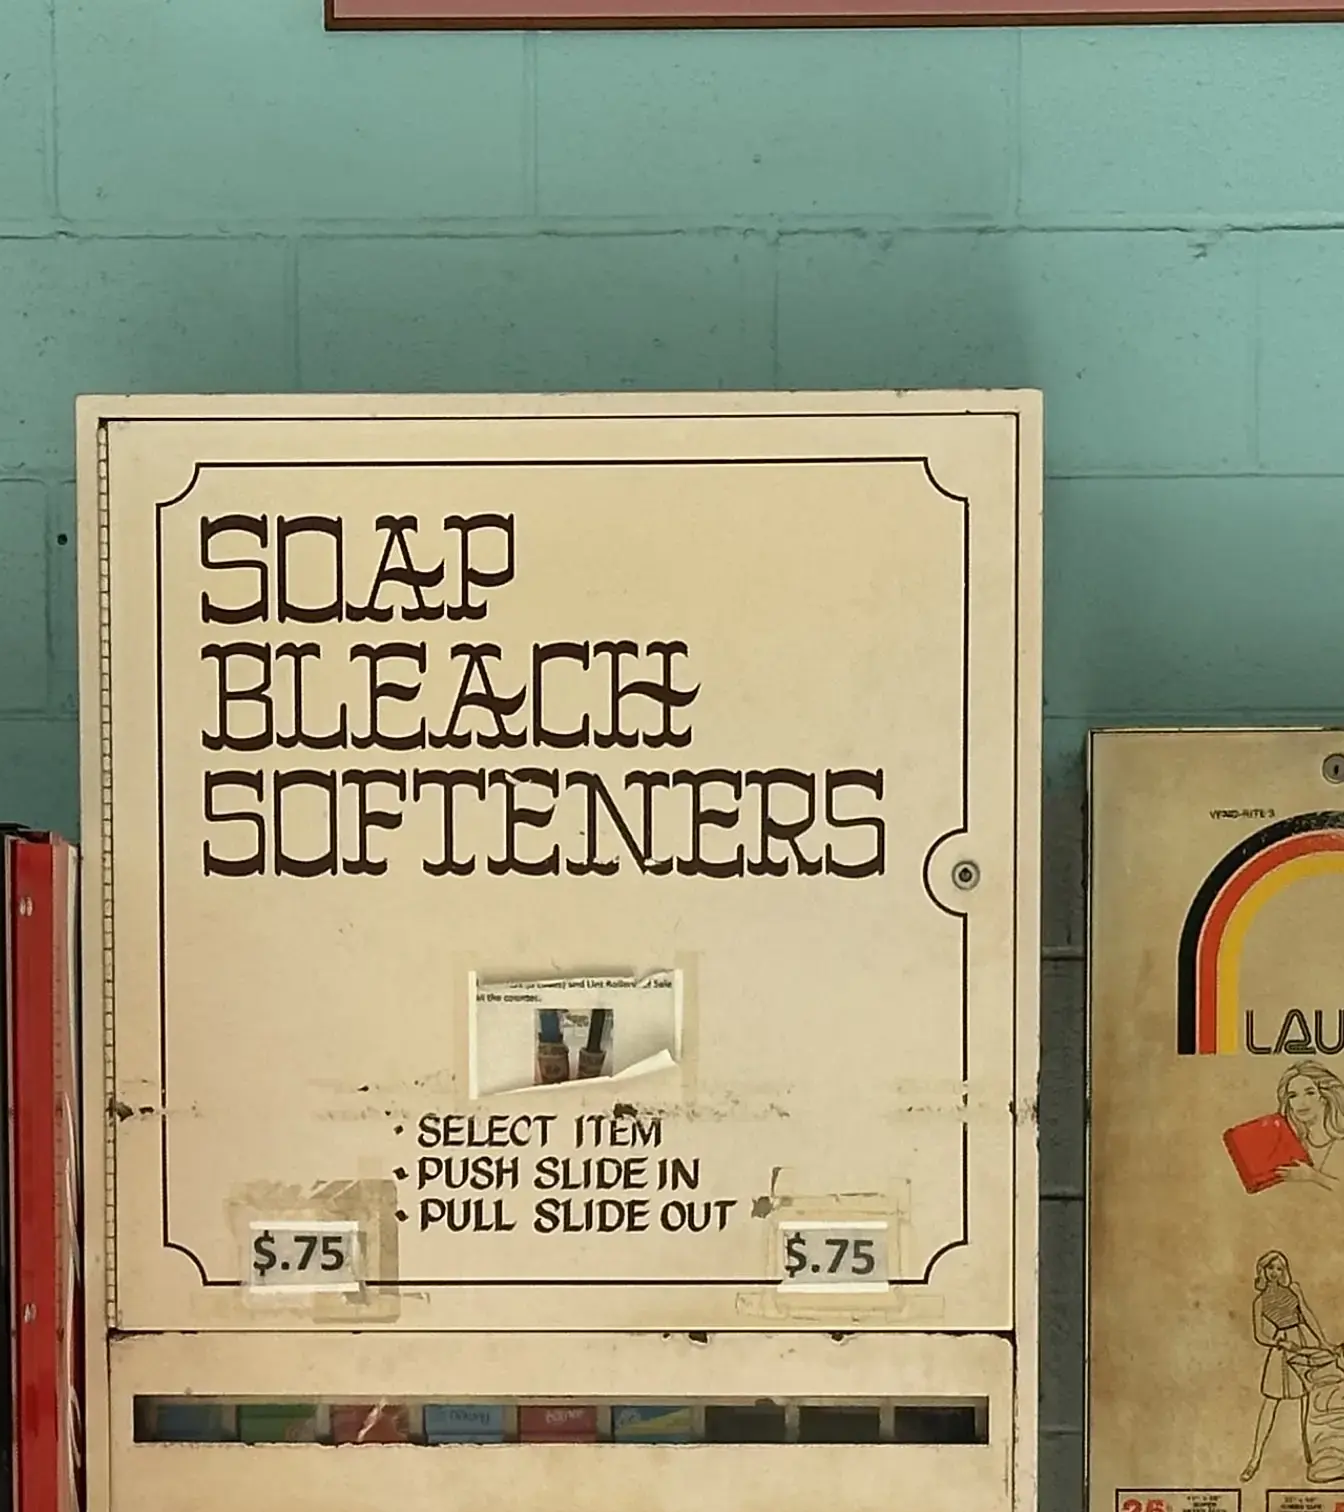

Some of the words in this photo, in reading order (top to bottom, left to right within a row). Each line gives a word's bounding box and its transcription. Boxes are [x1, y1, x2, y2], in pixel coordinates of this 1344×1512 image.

[200, 514, 516, 624] SOAP
[201, 641, 701, 751] BLEACH
[202, 767, 885, 879] SOFTENERS
[417, 1114, 558, 1148] SELECT
[575, 1114, 664, 1148] ITEM
[417, 1156, 520, 1190] PUSH
[533, 1156, 650, 1190] SLIDE
[657, 1157, 700, 1190] IN
[419, 1198, 518, 1232] PULL
[533, 1198, 651, 1233] SLIDE
[659, 1199, 738, 1232] OUT
[253, 1229, 345, 1277] $.75
[784, 1231, 876, 1278] $.75
